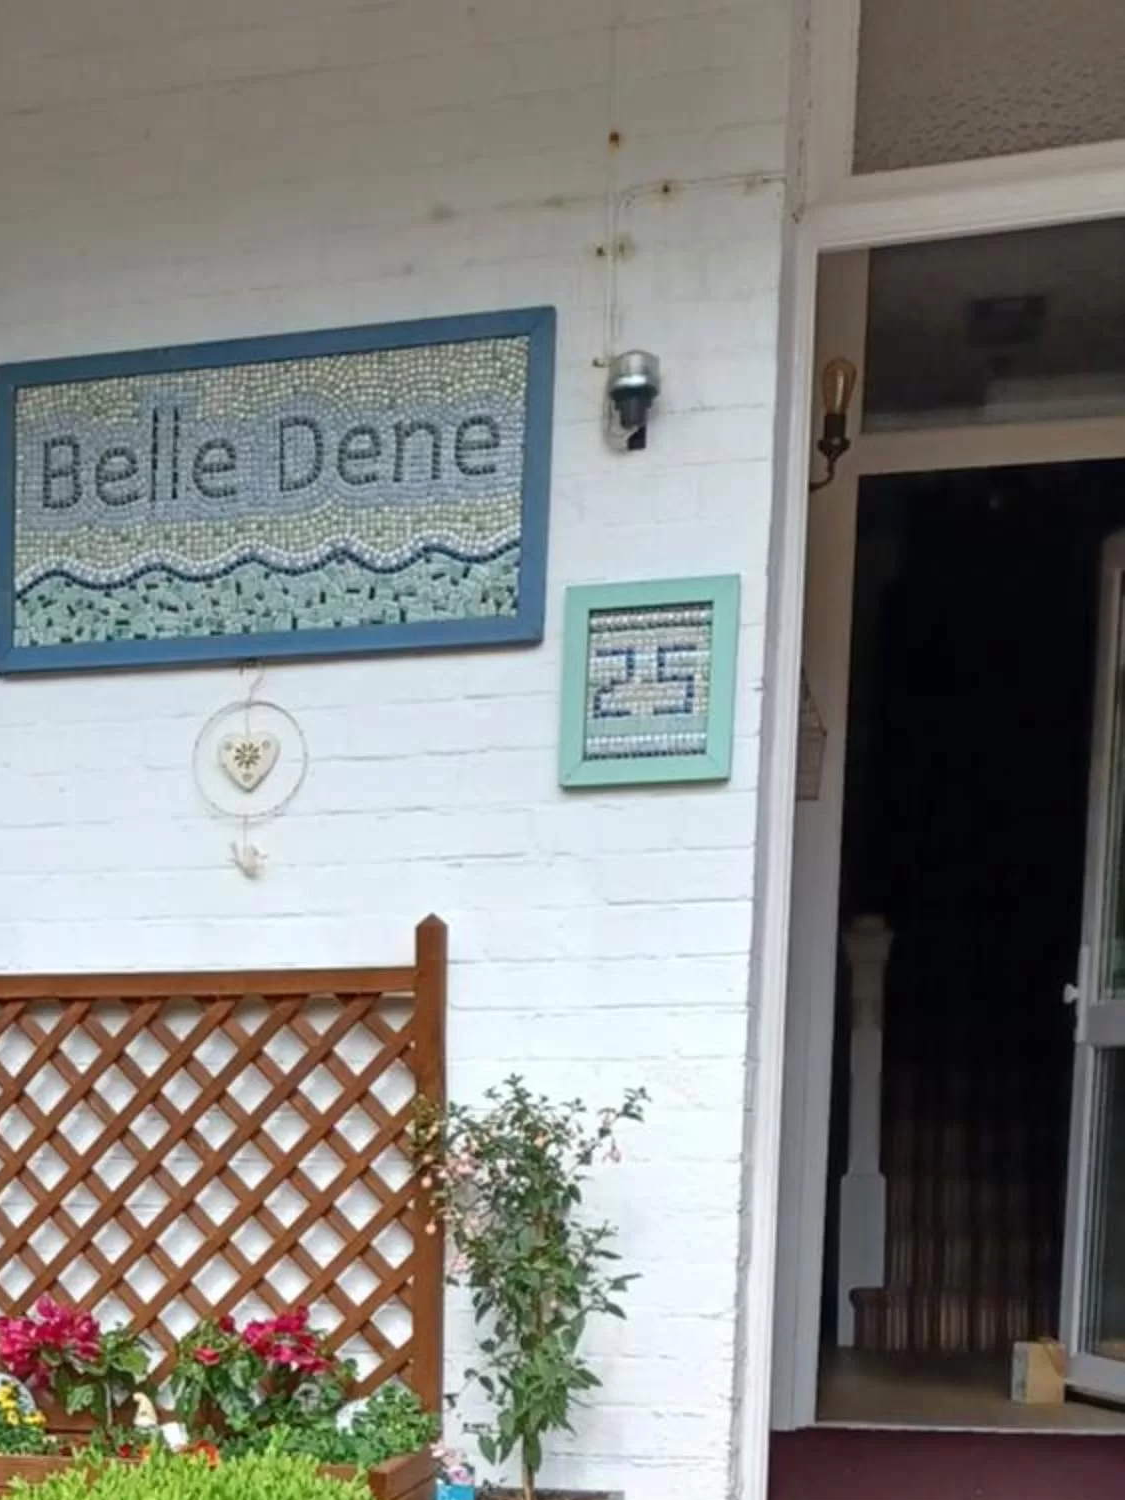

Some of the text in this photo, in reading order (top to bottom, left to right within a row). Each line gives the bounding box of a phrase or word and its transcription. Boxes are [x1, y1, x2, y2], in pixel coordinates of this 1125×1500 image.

[40, 404, 502, 511] Belle Dene
[591, 643, 696, 719] 25
